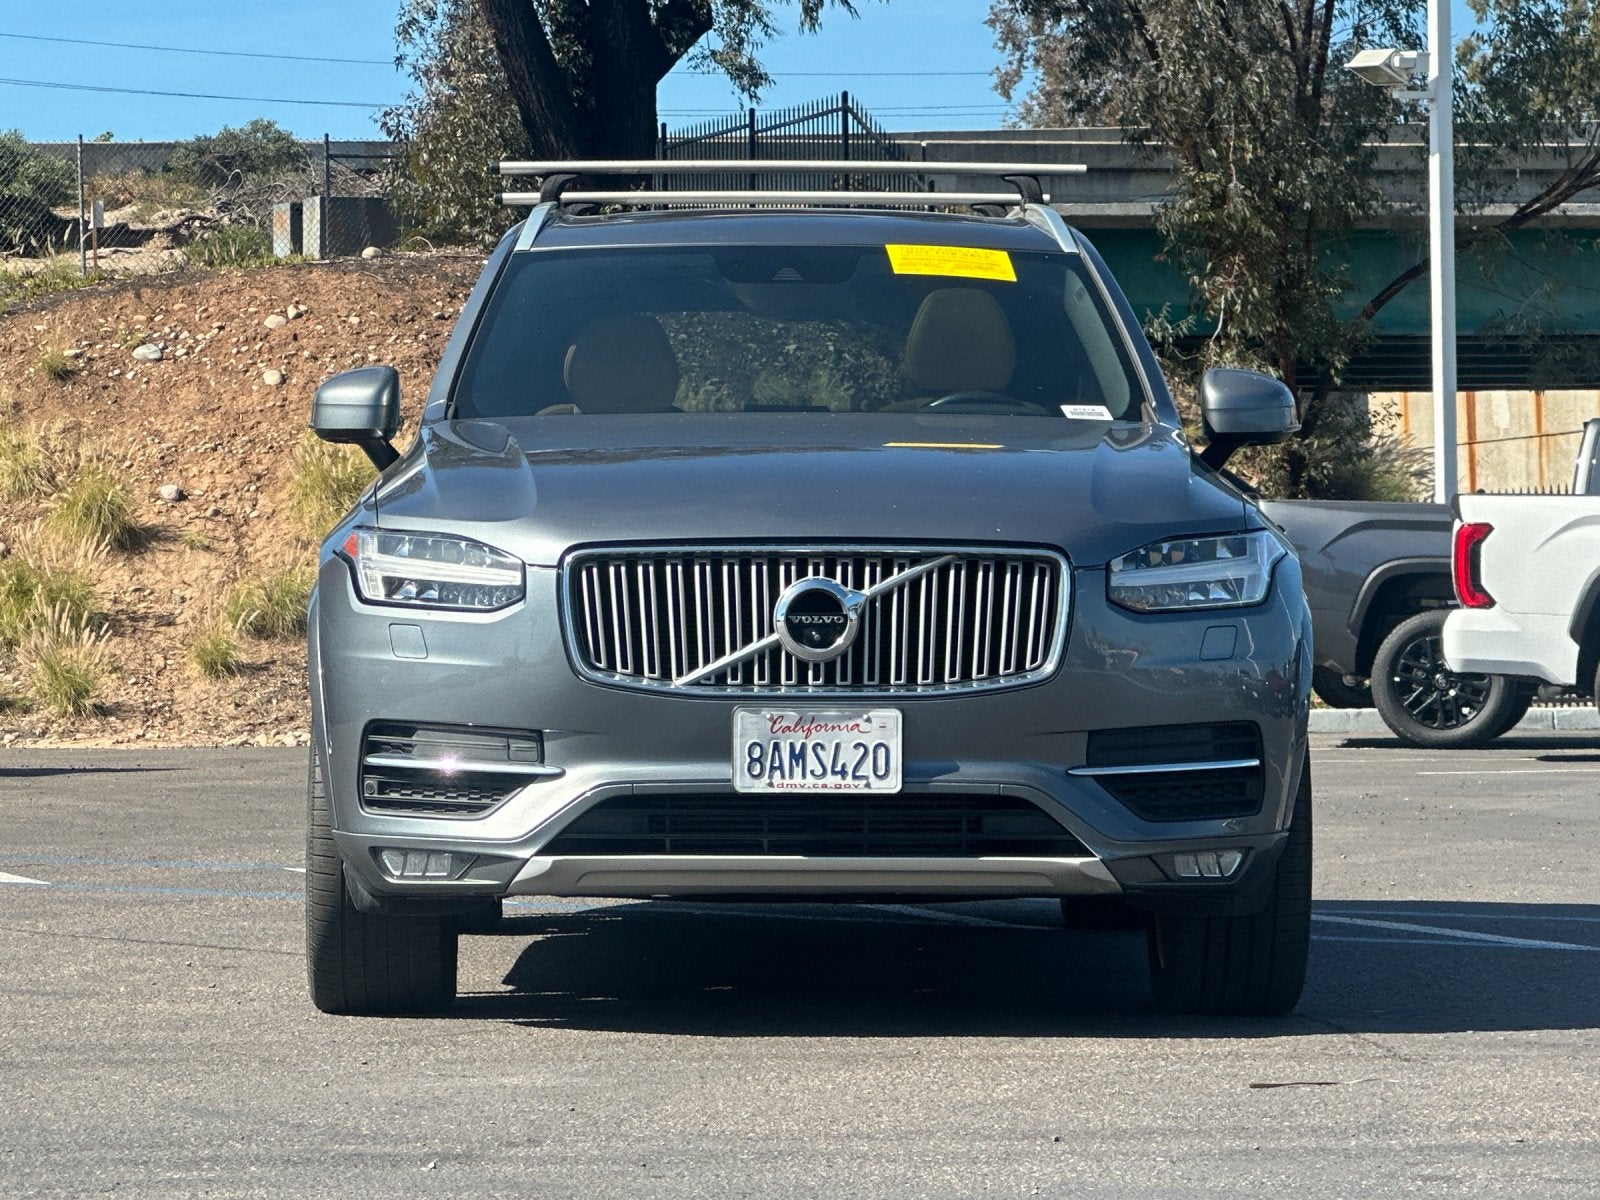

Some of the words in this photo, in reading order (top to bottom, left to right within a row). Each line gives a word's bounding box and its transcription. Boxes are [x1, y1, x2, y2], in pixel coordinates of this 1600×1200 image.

[788, 615, 845, 624] VOLVO
[770, 715, 871, 739] California
[746, 741, 890, 780] 8AMS420
[776, 781, 861, 790] dmv.ca.gov
